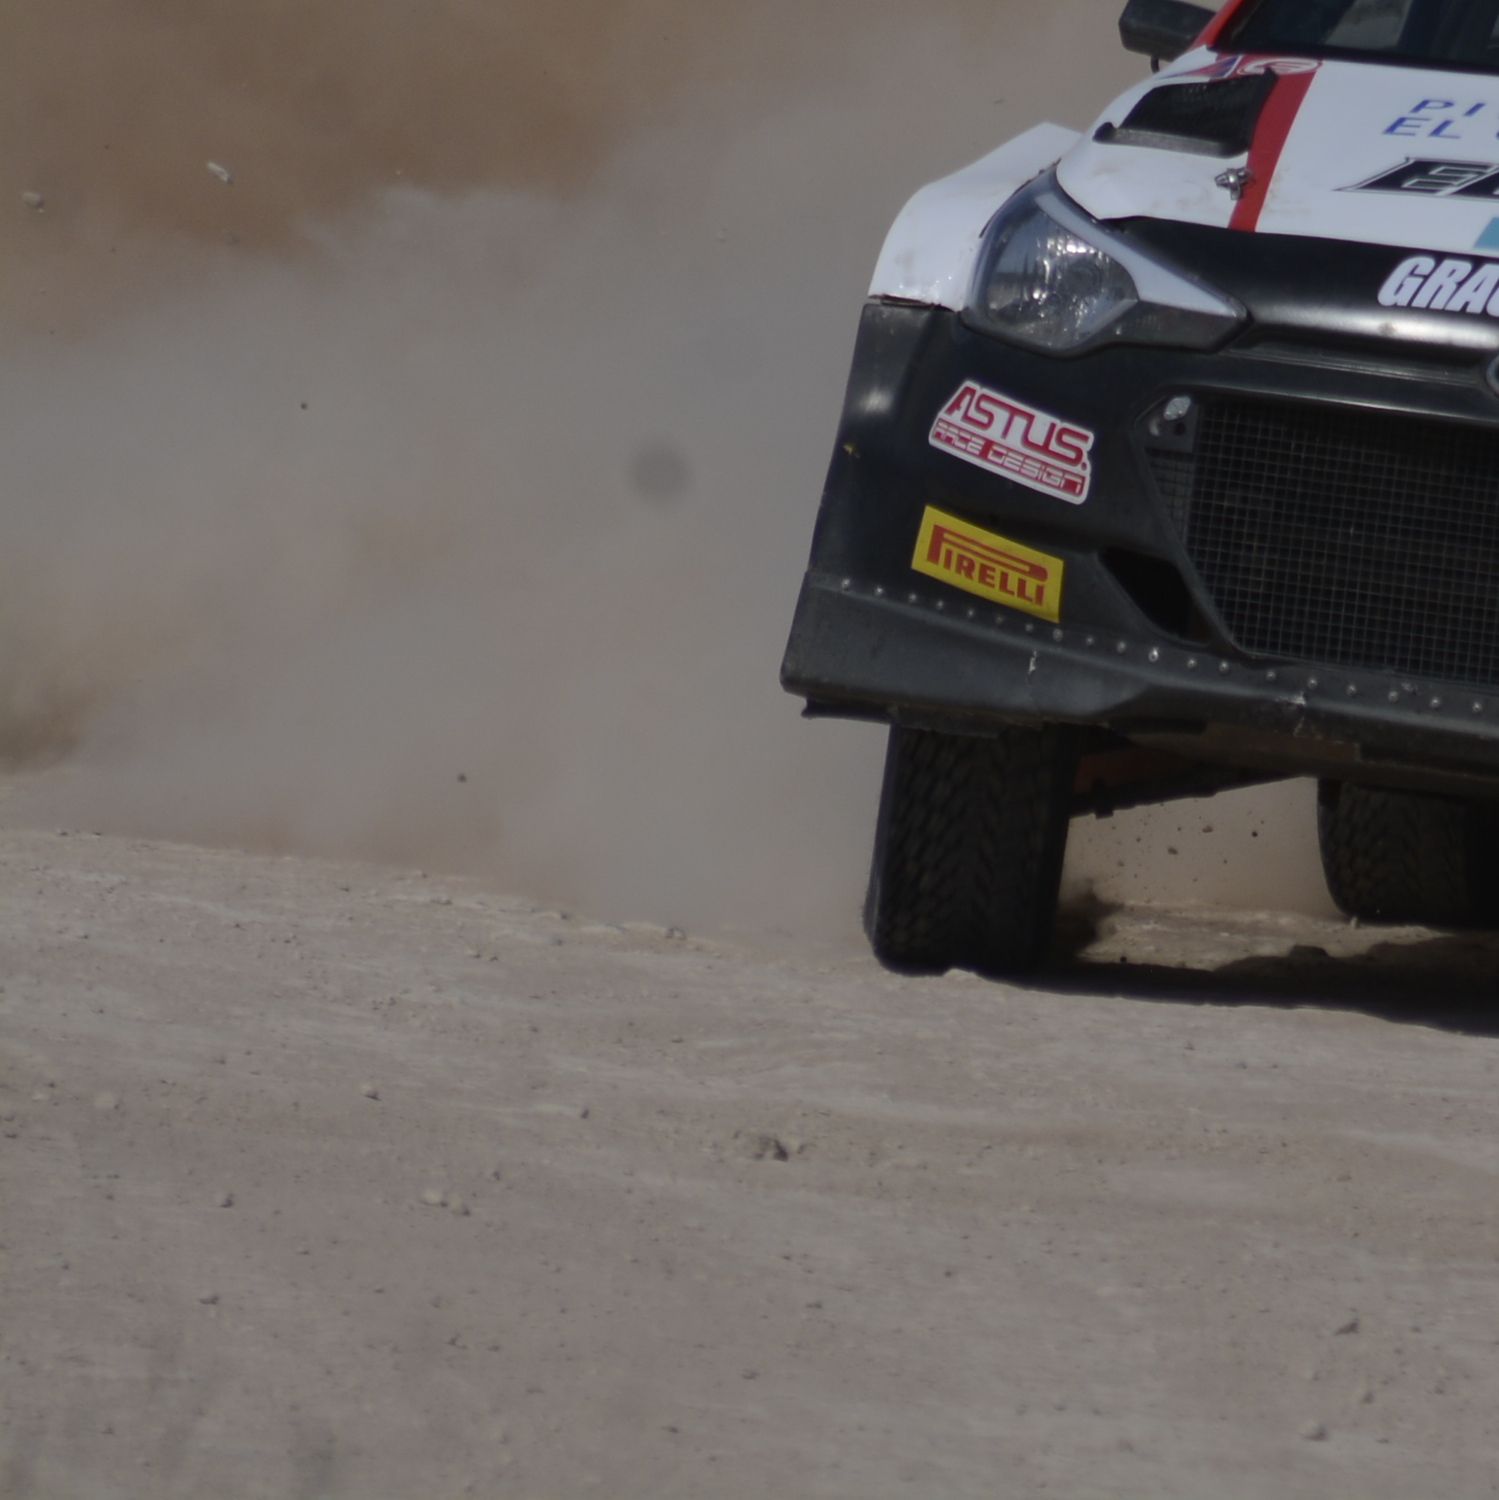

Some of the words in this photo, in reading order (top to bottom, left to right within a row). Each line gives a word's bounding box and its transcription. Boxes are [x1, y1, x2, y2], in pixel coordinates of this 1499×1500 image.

[1382, 115, 1462, 140] EL
[932, 421, 984, 456] RACE
[987, 444, 1084, 495] DESIGN
[926, 523, 1049, 607] PIRELLI
